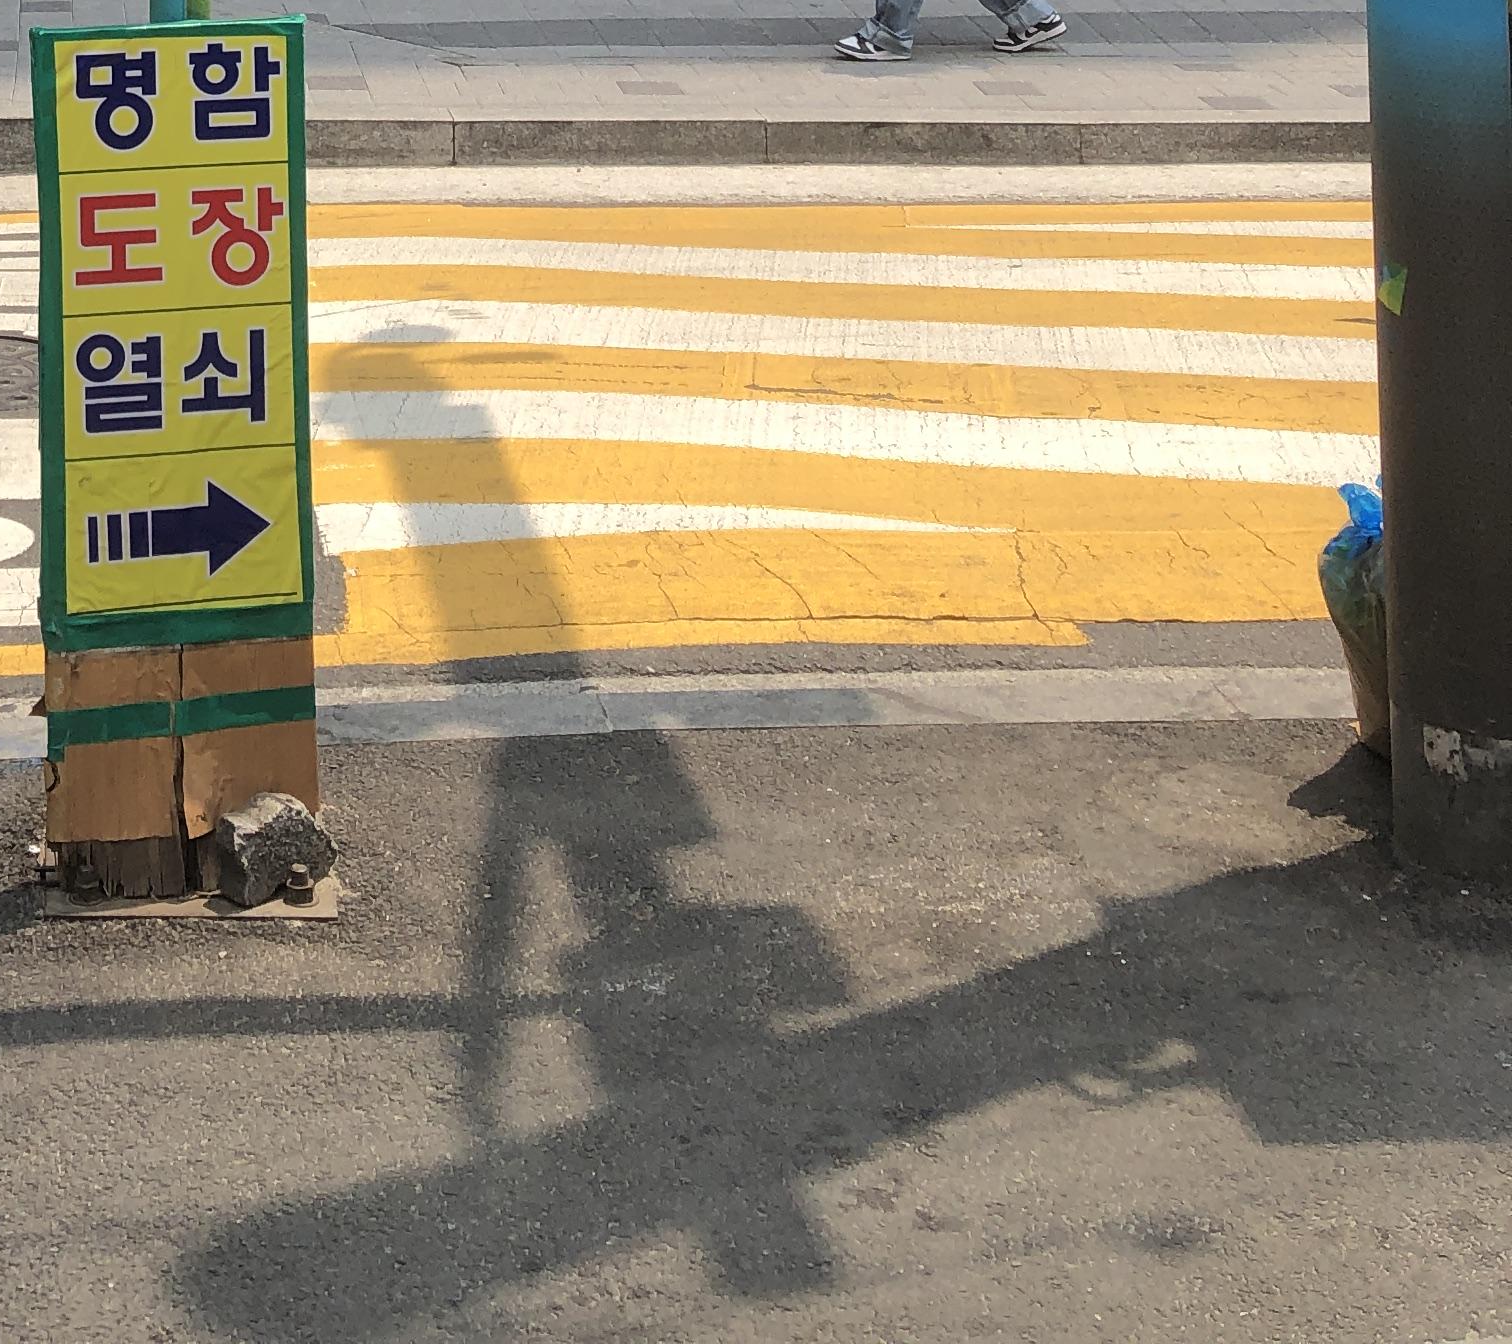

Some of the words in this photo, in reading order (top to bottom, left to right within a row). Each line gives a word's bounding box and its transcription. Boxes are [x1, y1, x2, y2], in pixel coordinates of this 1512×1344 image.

[75, 42, 281, 151] 명함
[74, 185, 285, 287] 도장
[74, 327, 267, 434] 열쇠
